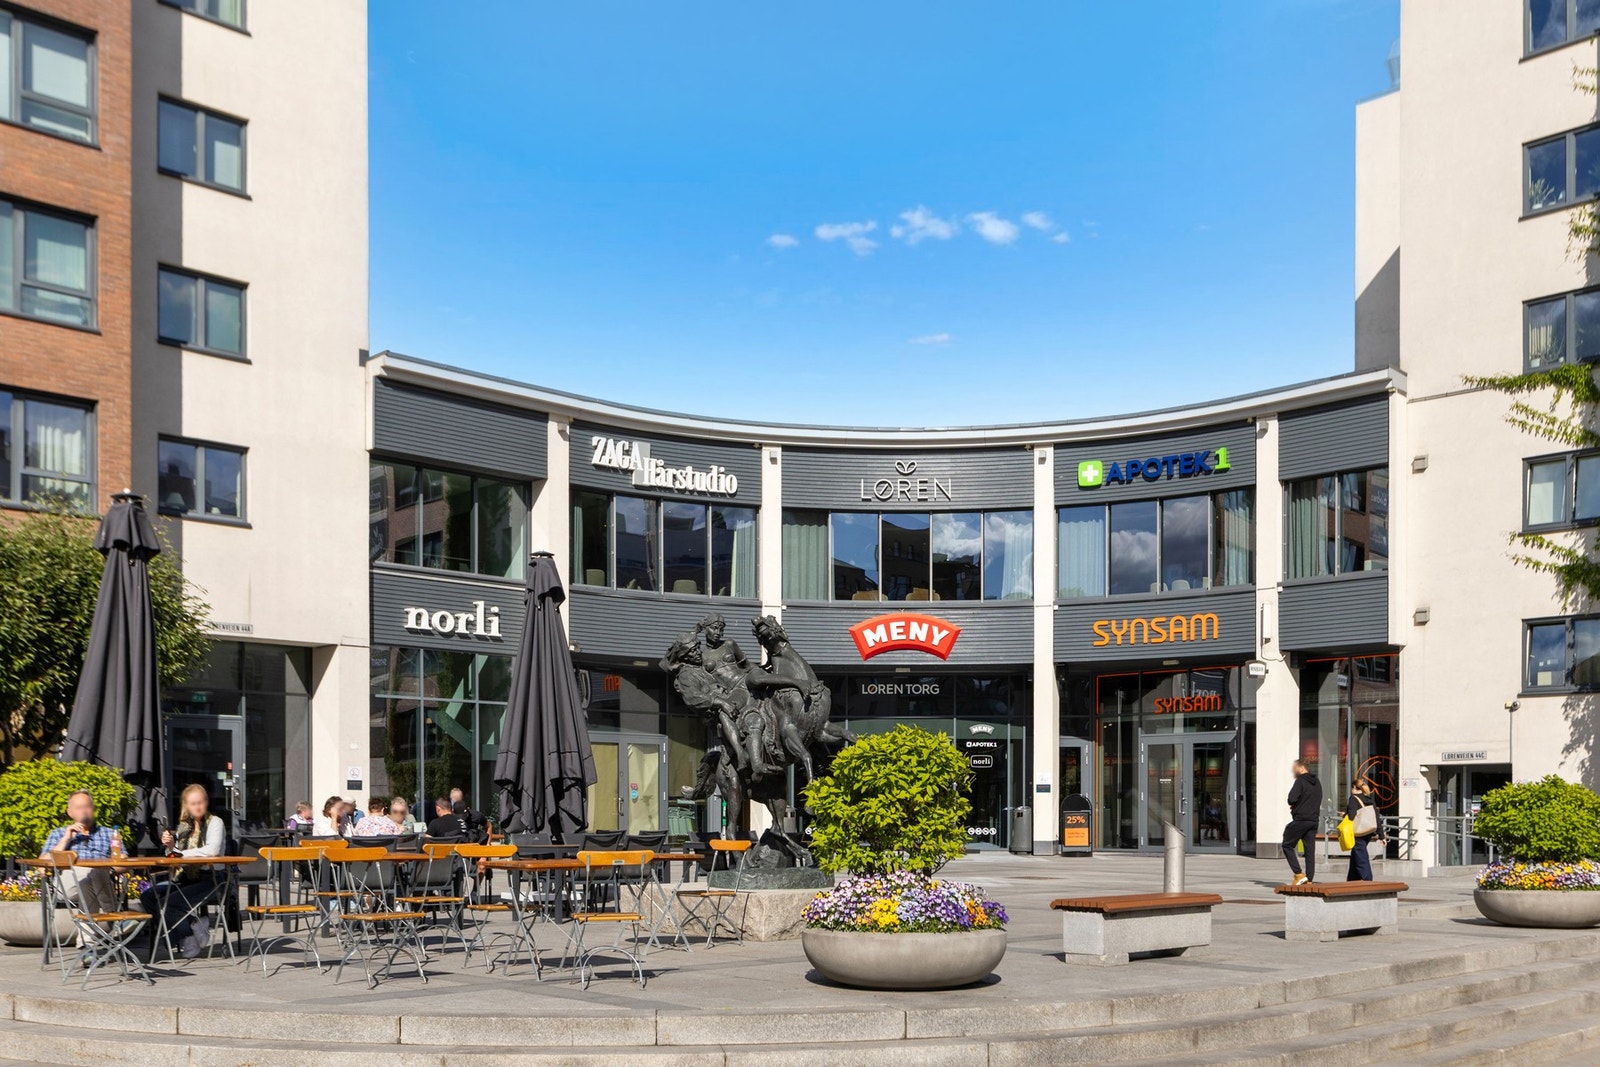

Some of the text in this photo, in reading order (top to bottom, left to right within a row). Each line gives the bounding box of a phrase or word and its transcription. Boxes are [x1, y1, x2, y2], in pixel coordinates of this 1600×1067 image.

[591, 436, 738, 495] ZAGA Hårstudio
[860, 478, 952, 500] LØREN
[404, 601, 502, 637] norli
[1092, 612, 1219, 647] SYNSAM
[862, 621, 950, 648] MENY
[905, 684, 940, 694] TORG
[1154, 694, 1222, 714] SYNSAM
[972, 725, 992, 733] MENY
[972, 757, 991, 765] norli
[1066, 815, 1086, 824] 25%
